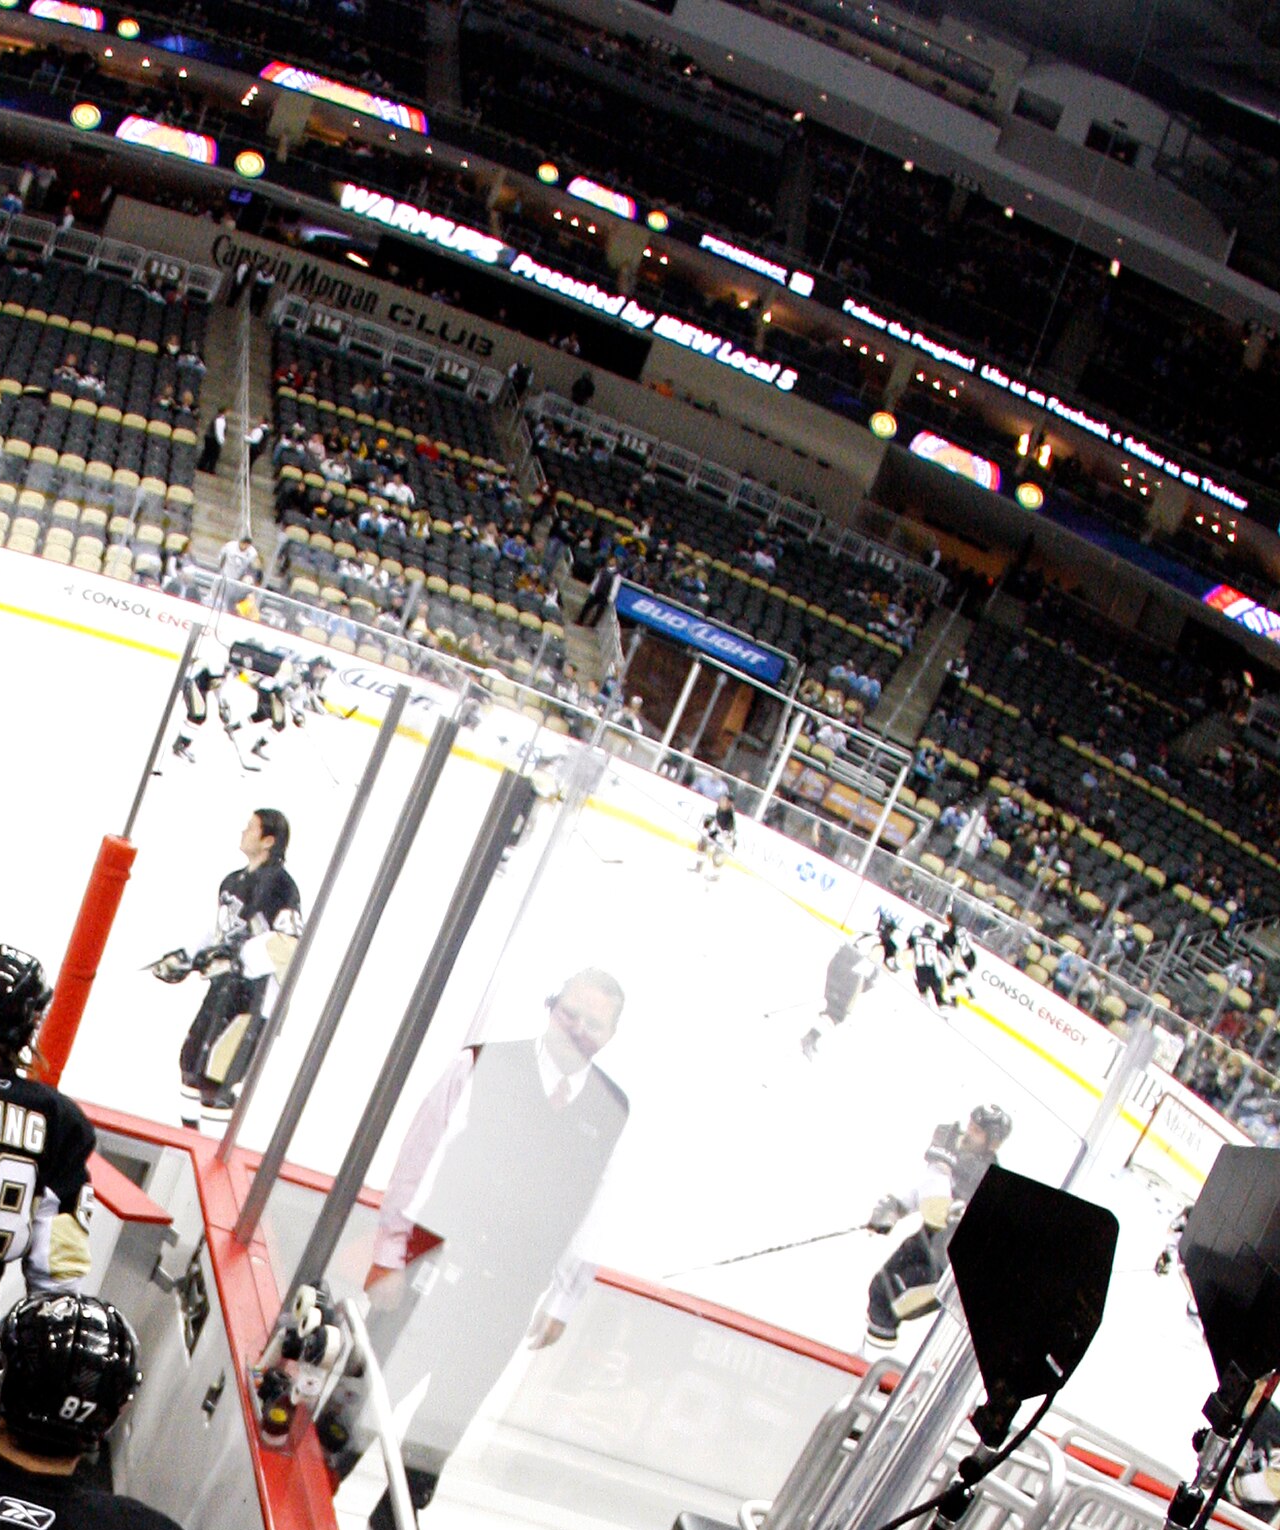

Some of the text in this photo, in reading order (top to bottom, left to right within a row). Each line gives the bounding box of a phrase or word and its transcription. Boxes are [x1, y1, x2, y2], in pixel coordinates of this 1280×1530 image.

[150, 261, 181, 282] 113
[340, 182, 799, 393] WARMUPS Presented by IBEW Local 5
[288, 262, 381, 316] Morgan
[388, 301, 495, 358] CLUB
[314, 312, 343, 334] 114
[1200, 475, 1249, 512] Twitter
[81, 588, 153, 620] CONSOL
[630, 598, 769, 666] BUD LIGHT
[980, 969, 1090, 1048] CONSOL ENERGY
[59, 1395, 98, 1423] 87
